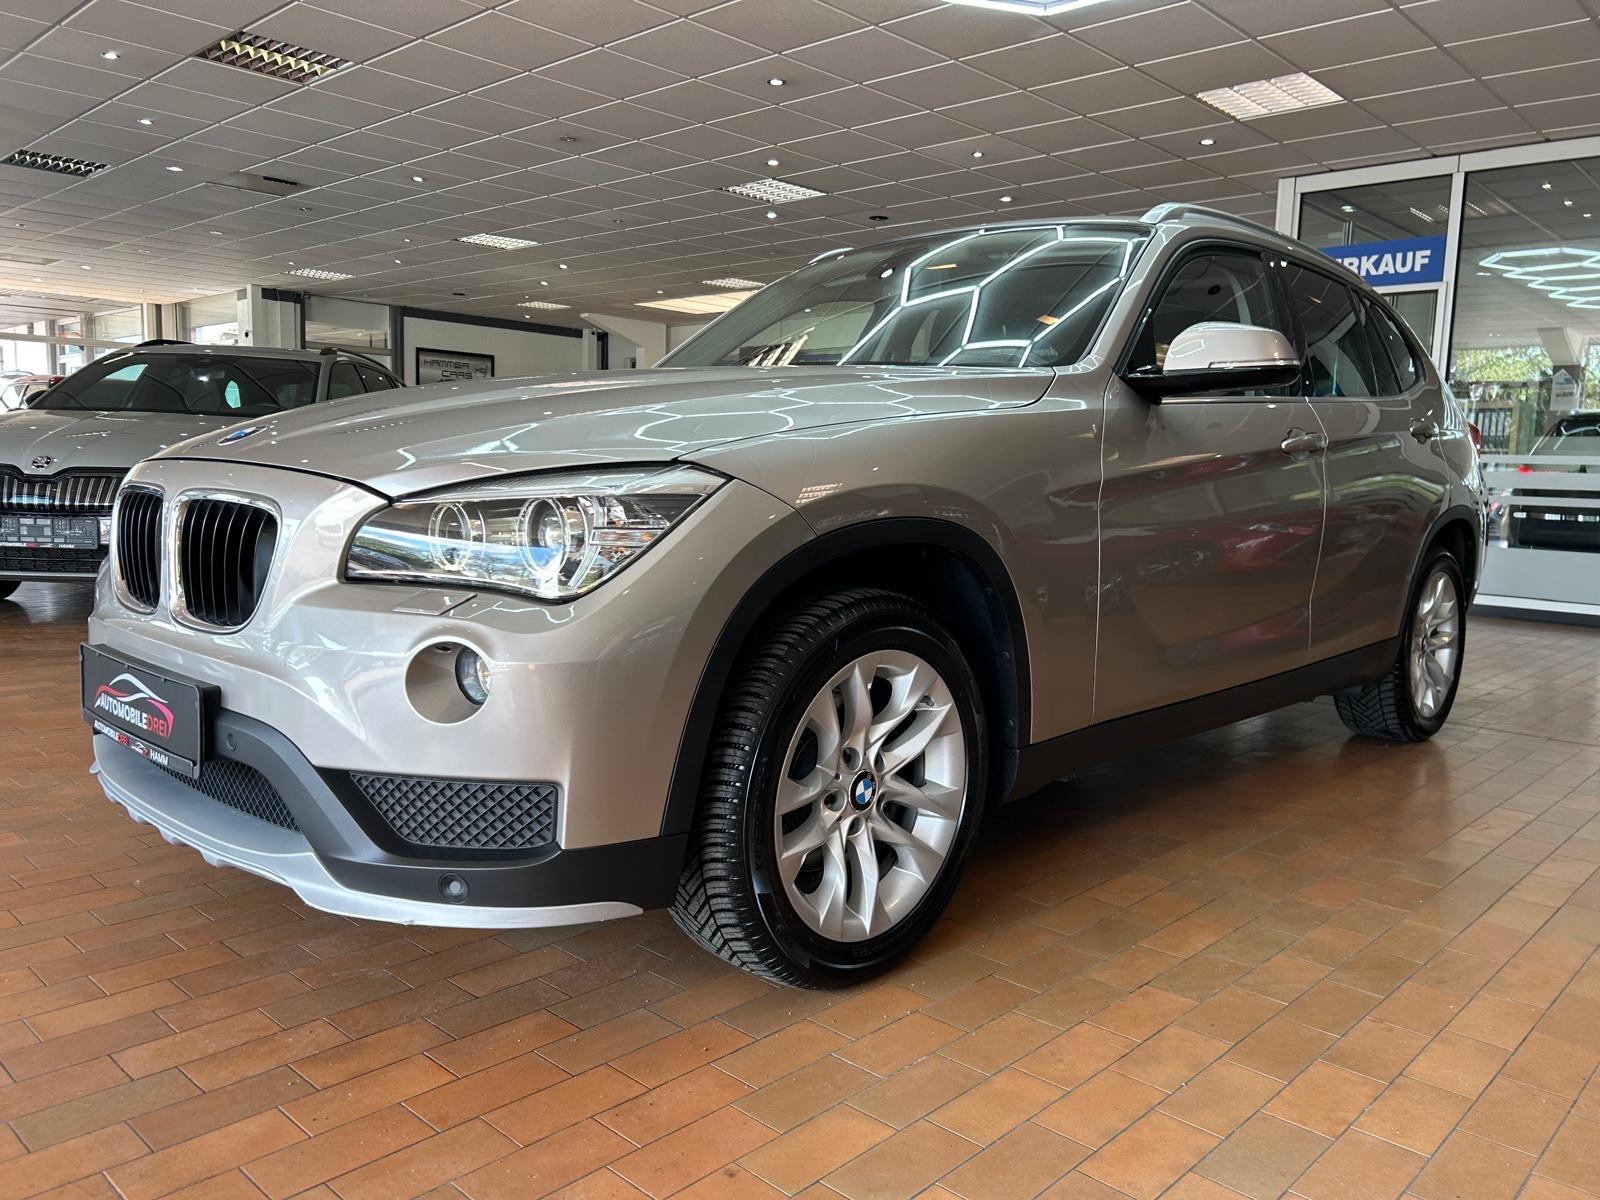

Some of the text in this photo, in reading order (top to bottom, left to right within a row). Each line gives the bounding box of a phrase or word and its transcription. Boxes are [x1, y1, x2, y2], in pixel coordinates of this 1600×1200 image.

[1336, 250, 1431, 276] RKAUF
[424, 360, 469, 369] HAMMER
[442, 370, 472, 379] CARS
[100, 693, 167, 738] AUTOMOBILEDREI
[150, 748, 168, 766] HAMM
